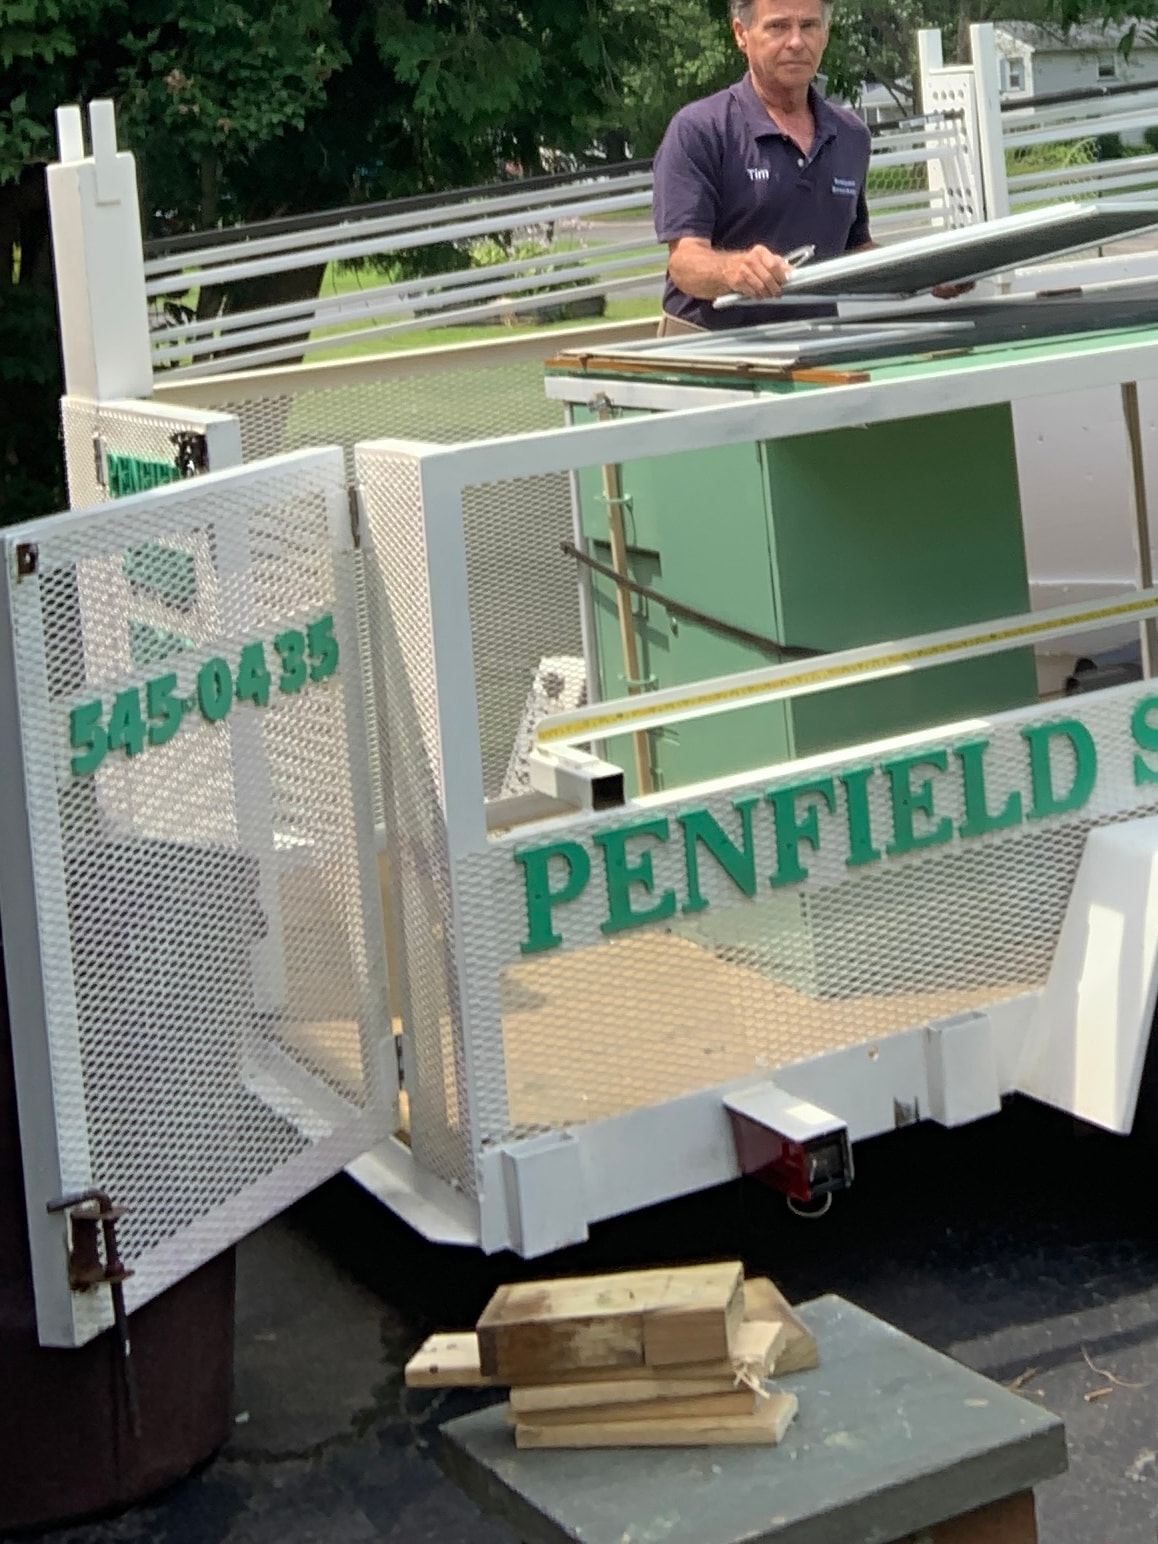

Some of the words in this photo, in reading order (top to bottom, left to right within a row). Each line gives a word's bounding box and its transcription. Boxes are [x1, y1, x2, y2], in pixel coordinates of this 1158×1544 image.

[747, 168, 769, 181] Tim
[70, 612, 339, 776] 545-0435
[515, 719, 1098, 953] PENFIELD
